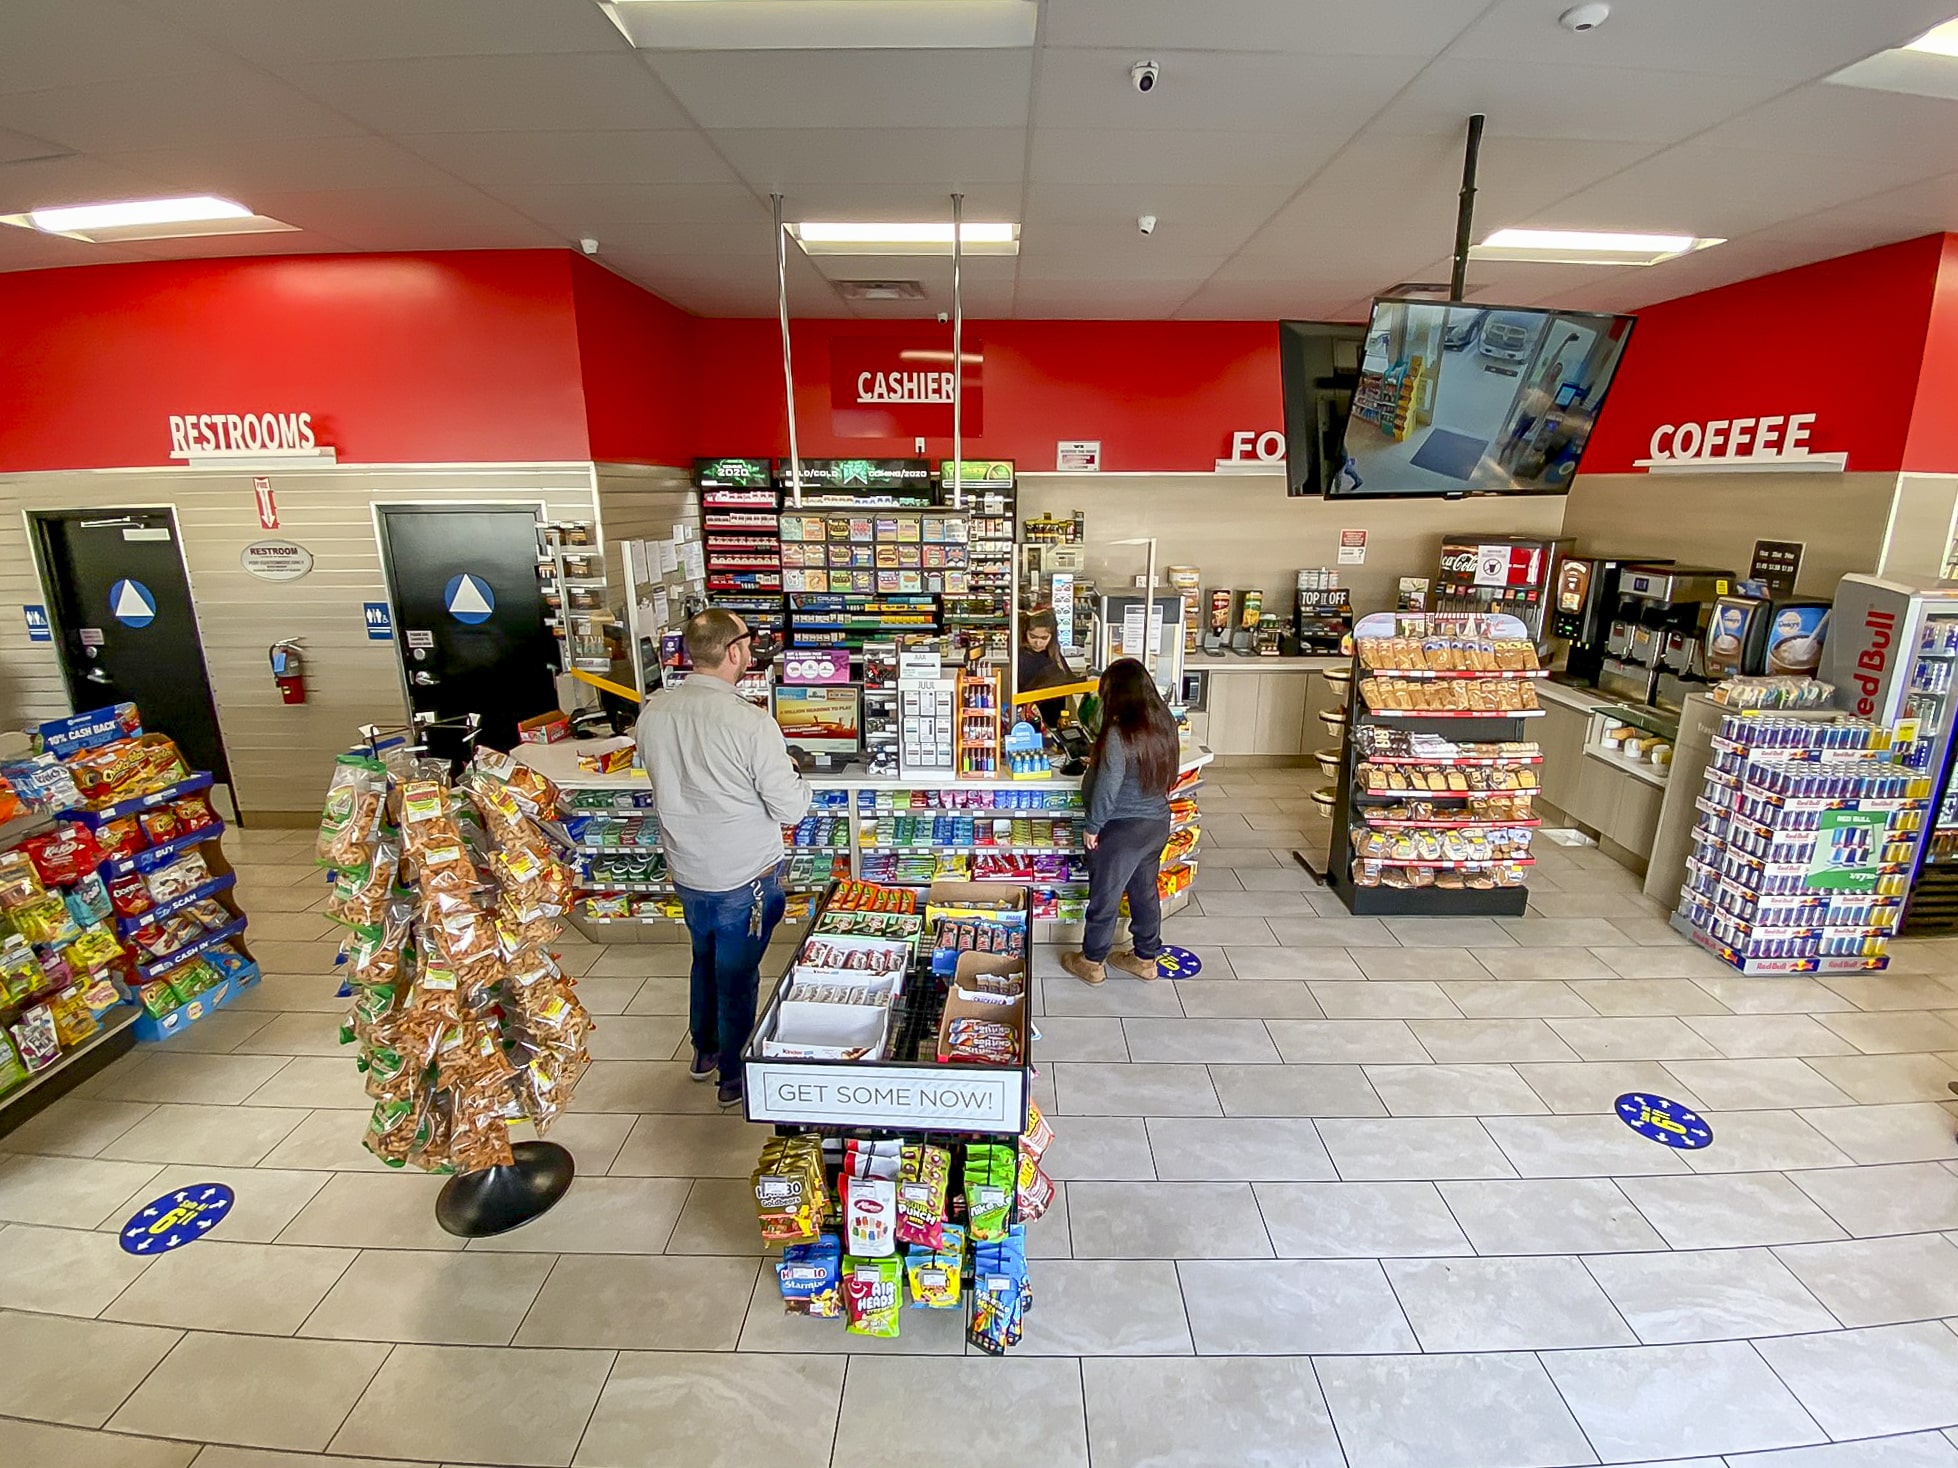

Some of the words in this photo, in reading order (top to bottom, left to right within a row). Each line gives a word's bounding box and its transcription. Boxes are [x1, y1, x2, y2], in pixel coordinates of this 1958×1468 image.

[857, 371, 955, 400] CASHIER
[169, 412, 315, 451] RESTROOMS
[1649, 413, 1816, 461] COFFEE
[717, 468, 748, 477] 2020
[785, 470, 838, 478] BLD/COLD
[250, 547, 298, 556] RESTROOM
[1302, 592, 1320, 604] TOP
[1328, 592, 1346, 604] OFF
[1858, 610, 1896, 672] Bull
[918, 681, 935, 690] JUUL
[48, 735, 67, 746] 10%
[68, 727, 92, 740] CASH
[93, 720, 116, 733] BACK
[155, 844, 174, 858] BUY
[172, 893, 197, 909] SCAN
[174, 948, 198, 963] CASH
[199, 941, 209, 950] IN
[778, 1084, 828, 1103] GET
[836, 1086, 912, 1106] SOME
[920, 1088, 993, 1110] NOW!
[1650, 1115, 1687, 1134] 6
[148, 1207, 187, 1234] 6
[898, 1204, 936, 1225] PUNCH
[784, 1280, 826, 1294] Starmix
[872, 1282, 895, 1296] AIR
[858, 1295, 894, 1312] HEADS
